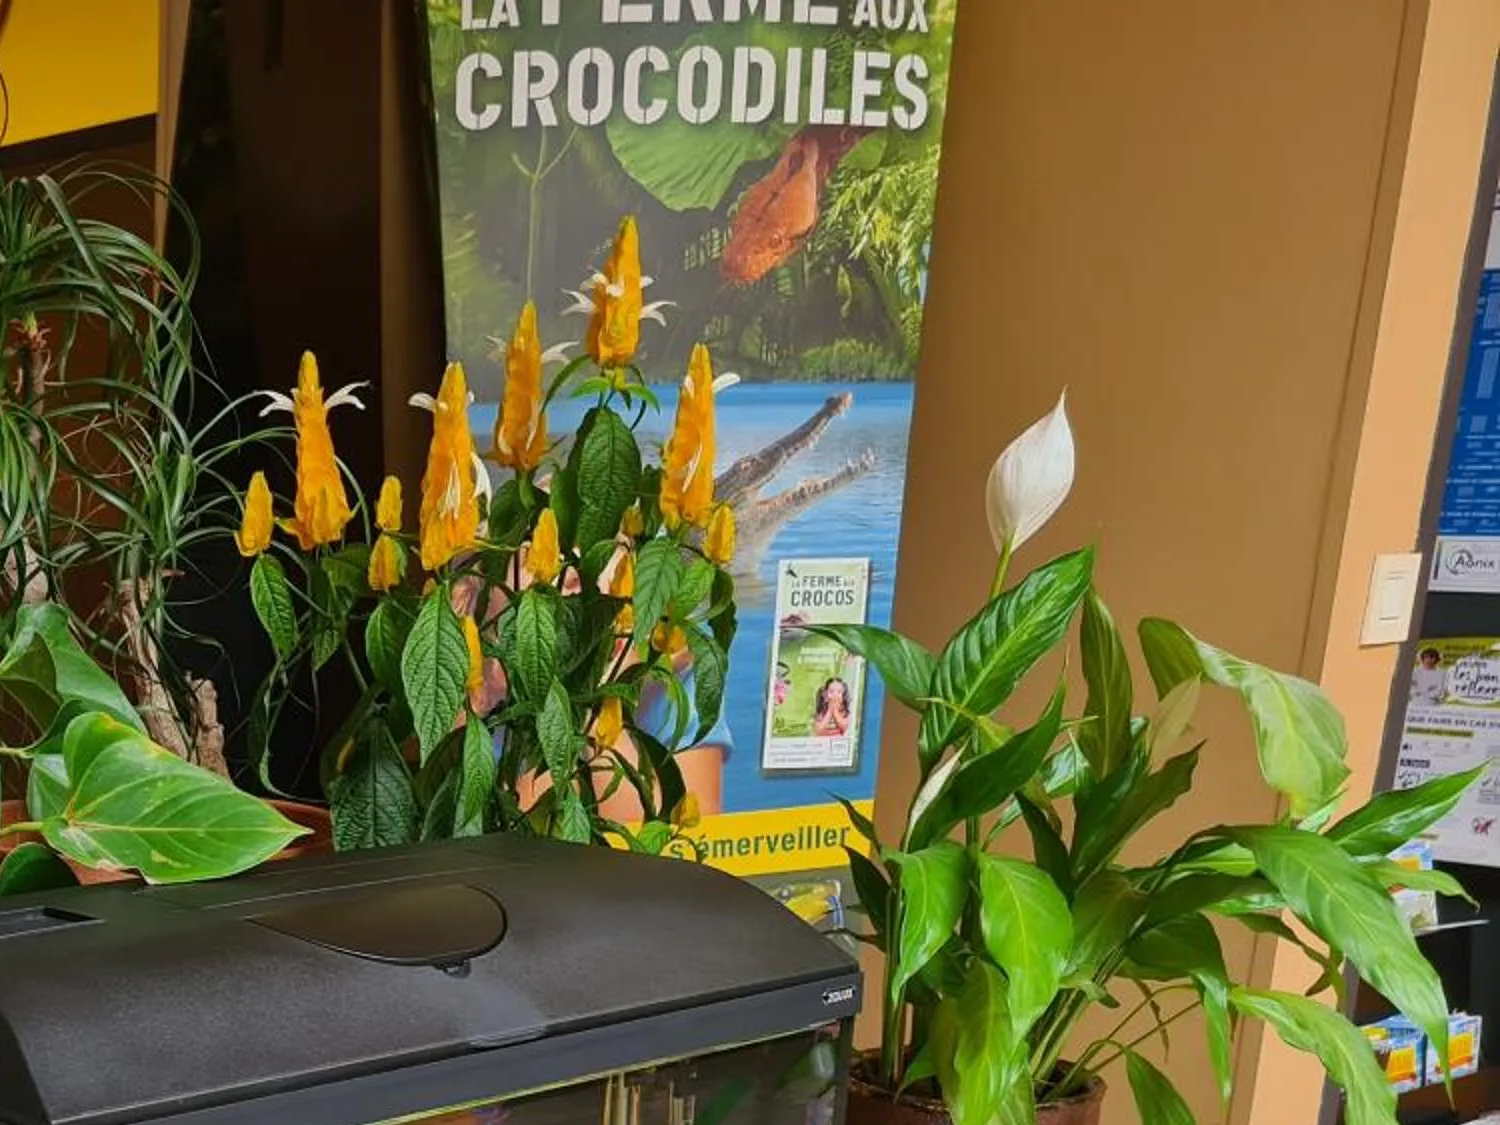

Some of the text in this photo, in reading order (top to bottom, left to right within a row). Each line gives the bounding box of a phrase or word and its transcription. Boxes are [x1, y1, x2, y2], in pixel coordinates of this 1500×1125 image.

[455, 46, 930, 131] CROCODILES
[802, 575, 844, 588] FERME
[791, 589, 855, 607] CROCOS
